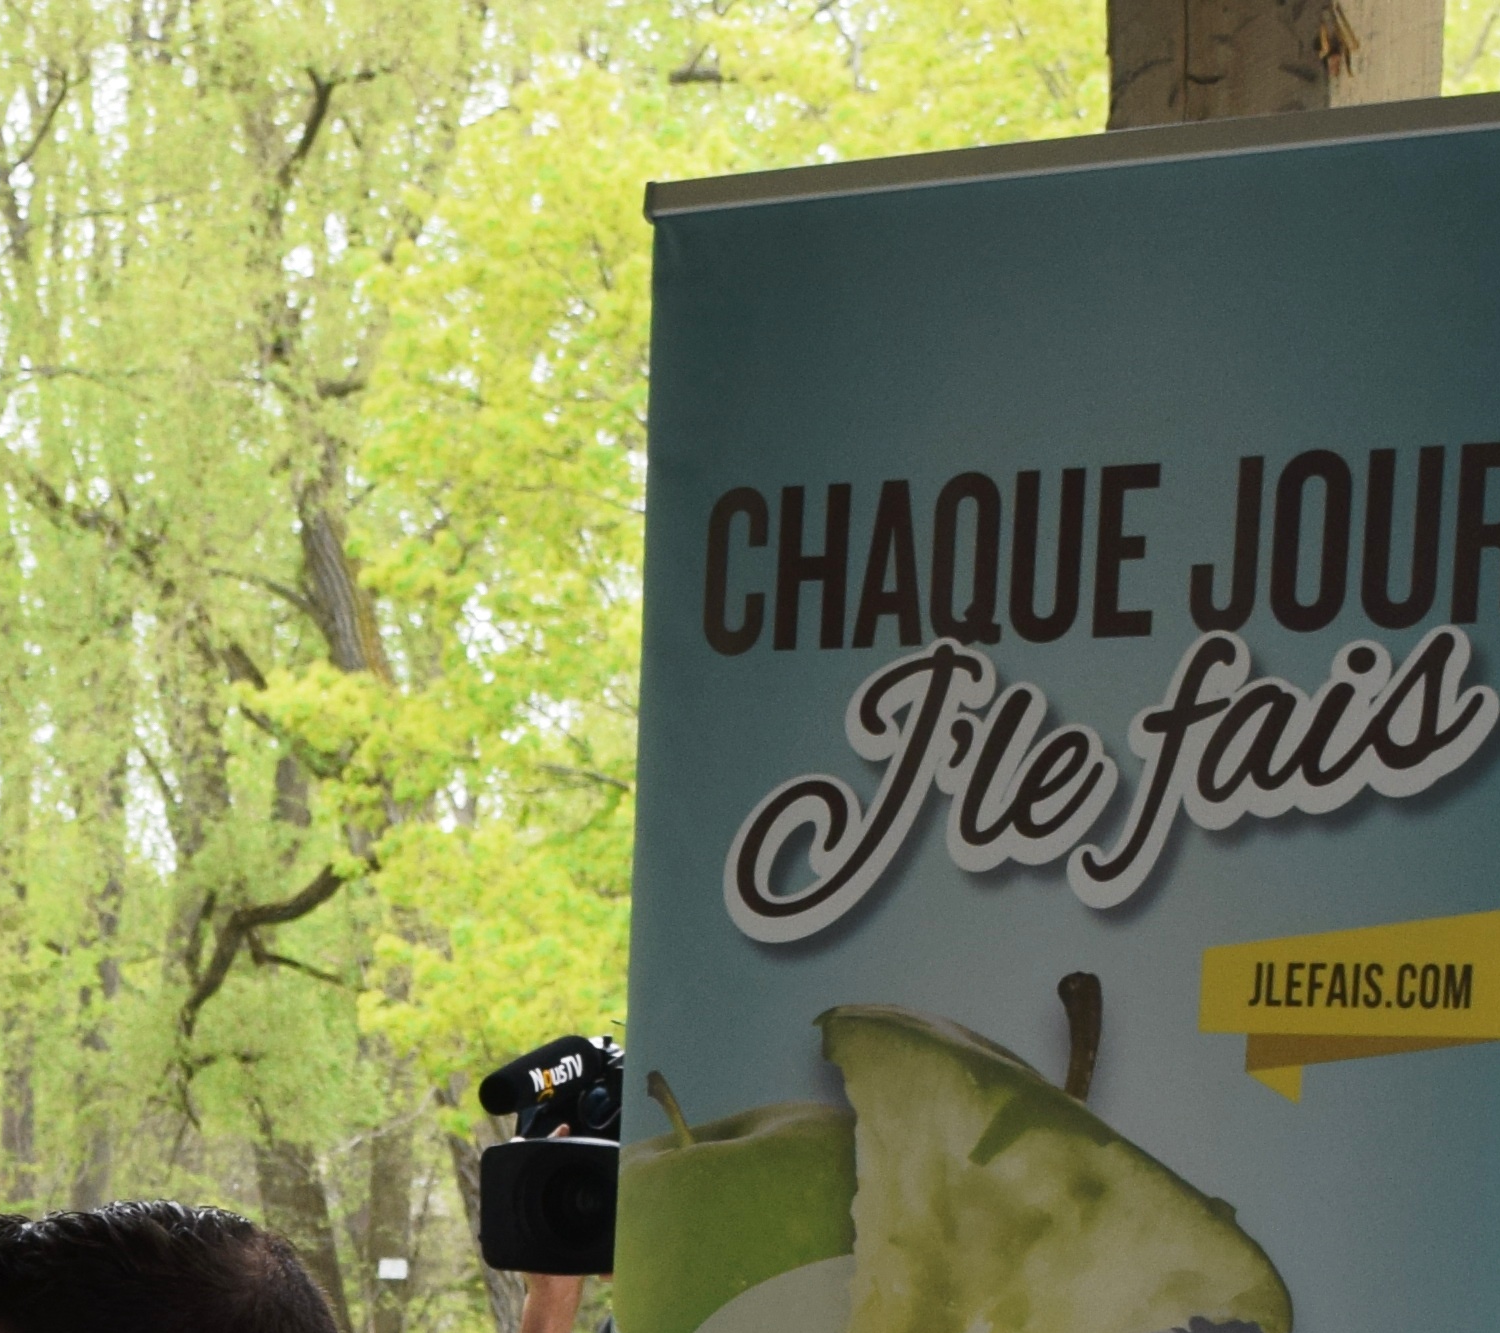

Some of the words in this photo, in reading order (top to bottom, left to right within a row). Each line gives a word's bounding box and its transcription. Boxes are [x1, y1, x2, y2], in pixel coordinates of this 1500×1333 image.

[703, 462, 1161, 656] CHAQUE
[1081, 630, 1485, 881] fais
[1247, 961, 1473, 1010] JLEFAIS.COM
